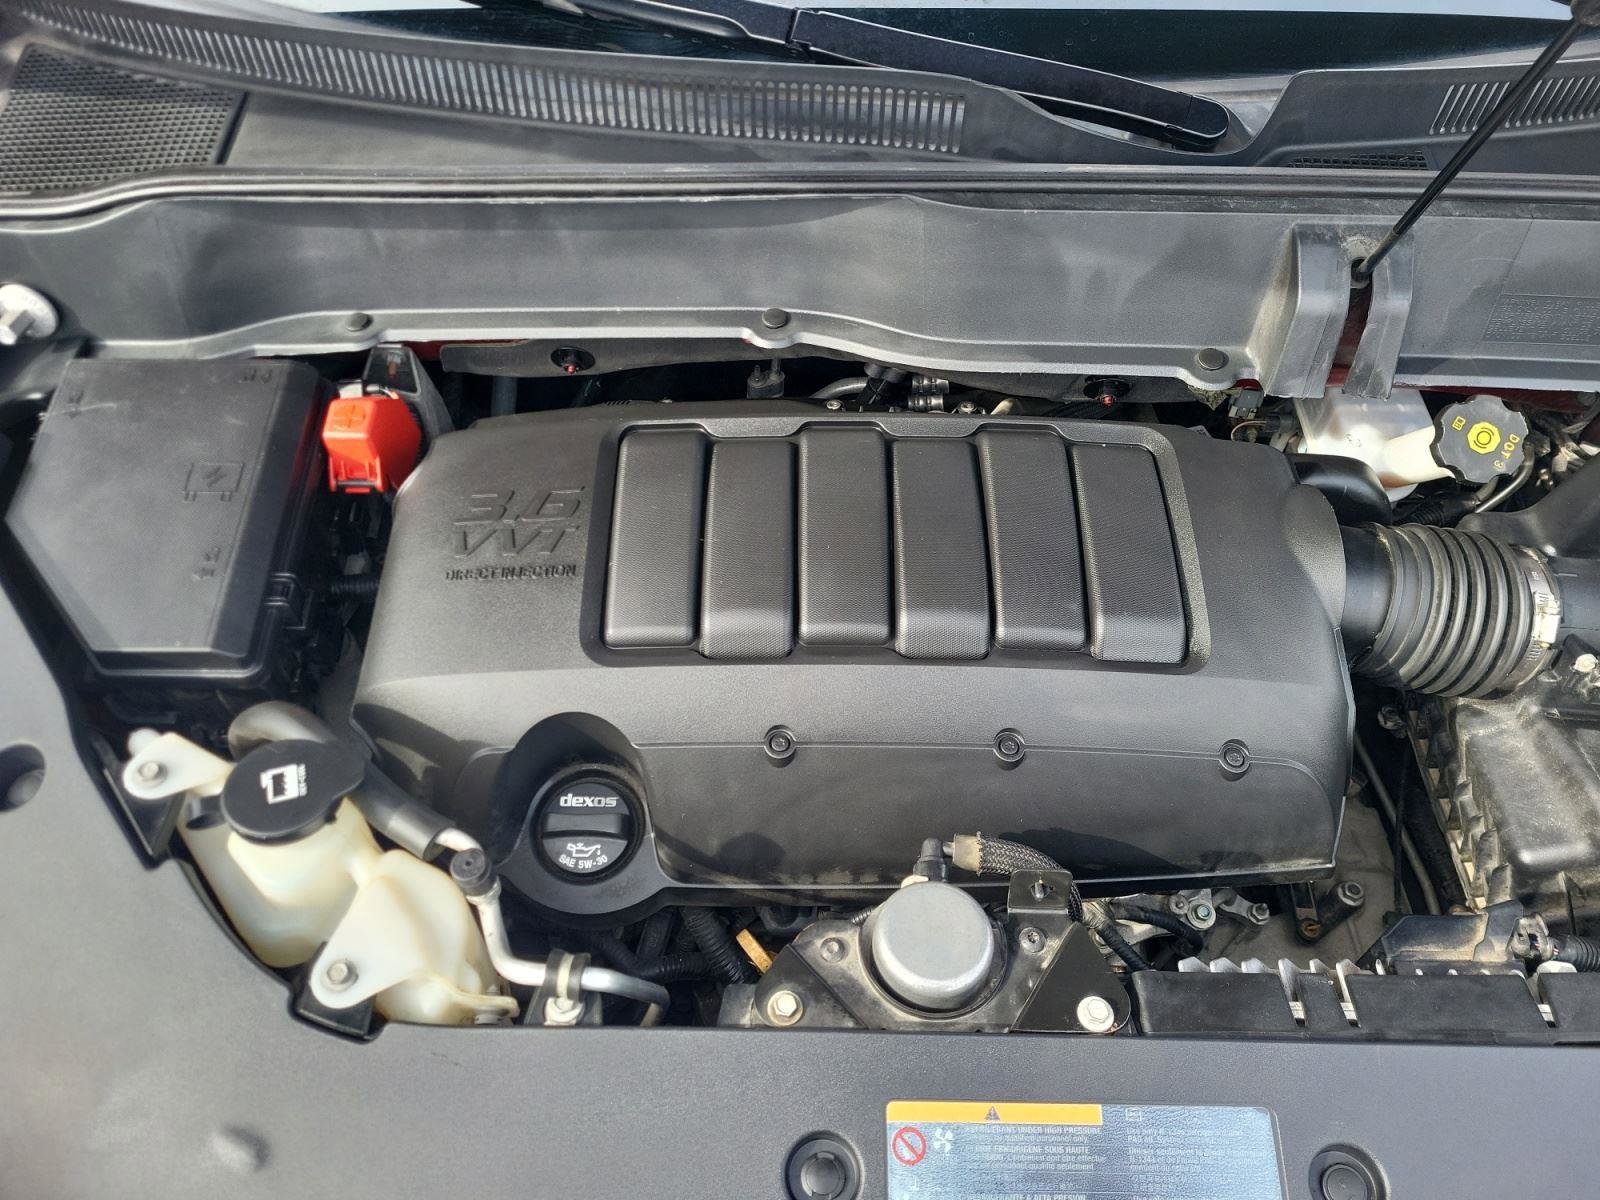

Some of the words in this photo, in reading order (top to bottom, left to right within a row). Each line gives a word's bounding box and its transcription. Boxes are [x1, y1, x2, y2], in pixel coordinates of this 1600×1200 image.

[1501, 434, 1520, 459] DOT
[1494, 460, 1506, 471] 3
[454, 486, 586, 524] 3.6
[451, 525, 581, 558] VVT
[445, 567, 499, 580] DIRECT
[501, 564, 577, 579] INJECTION
[559, 793, 619, 807] dexos
[559, 854, 577, 868] SAE
[578, 854, 608, 869] 5W-30
